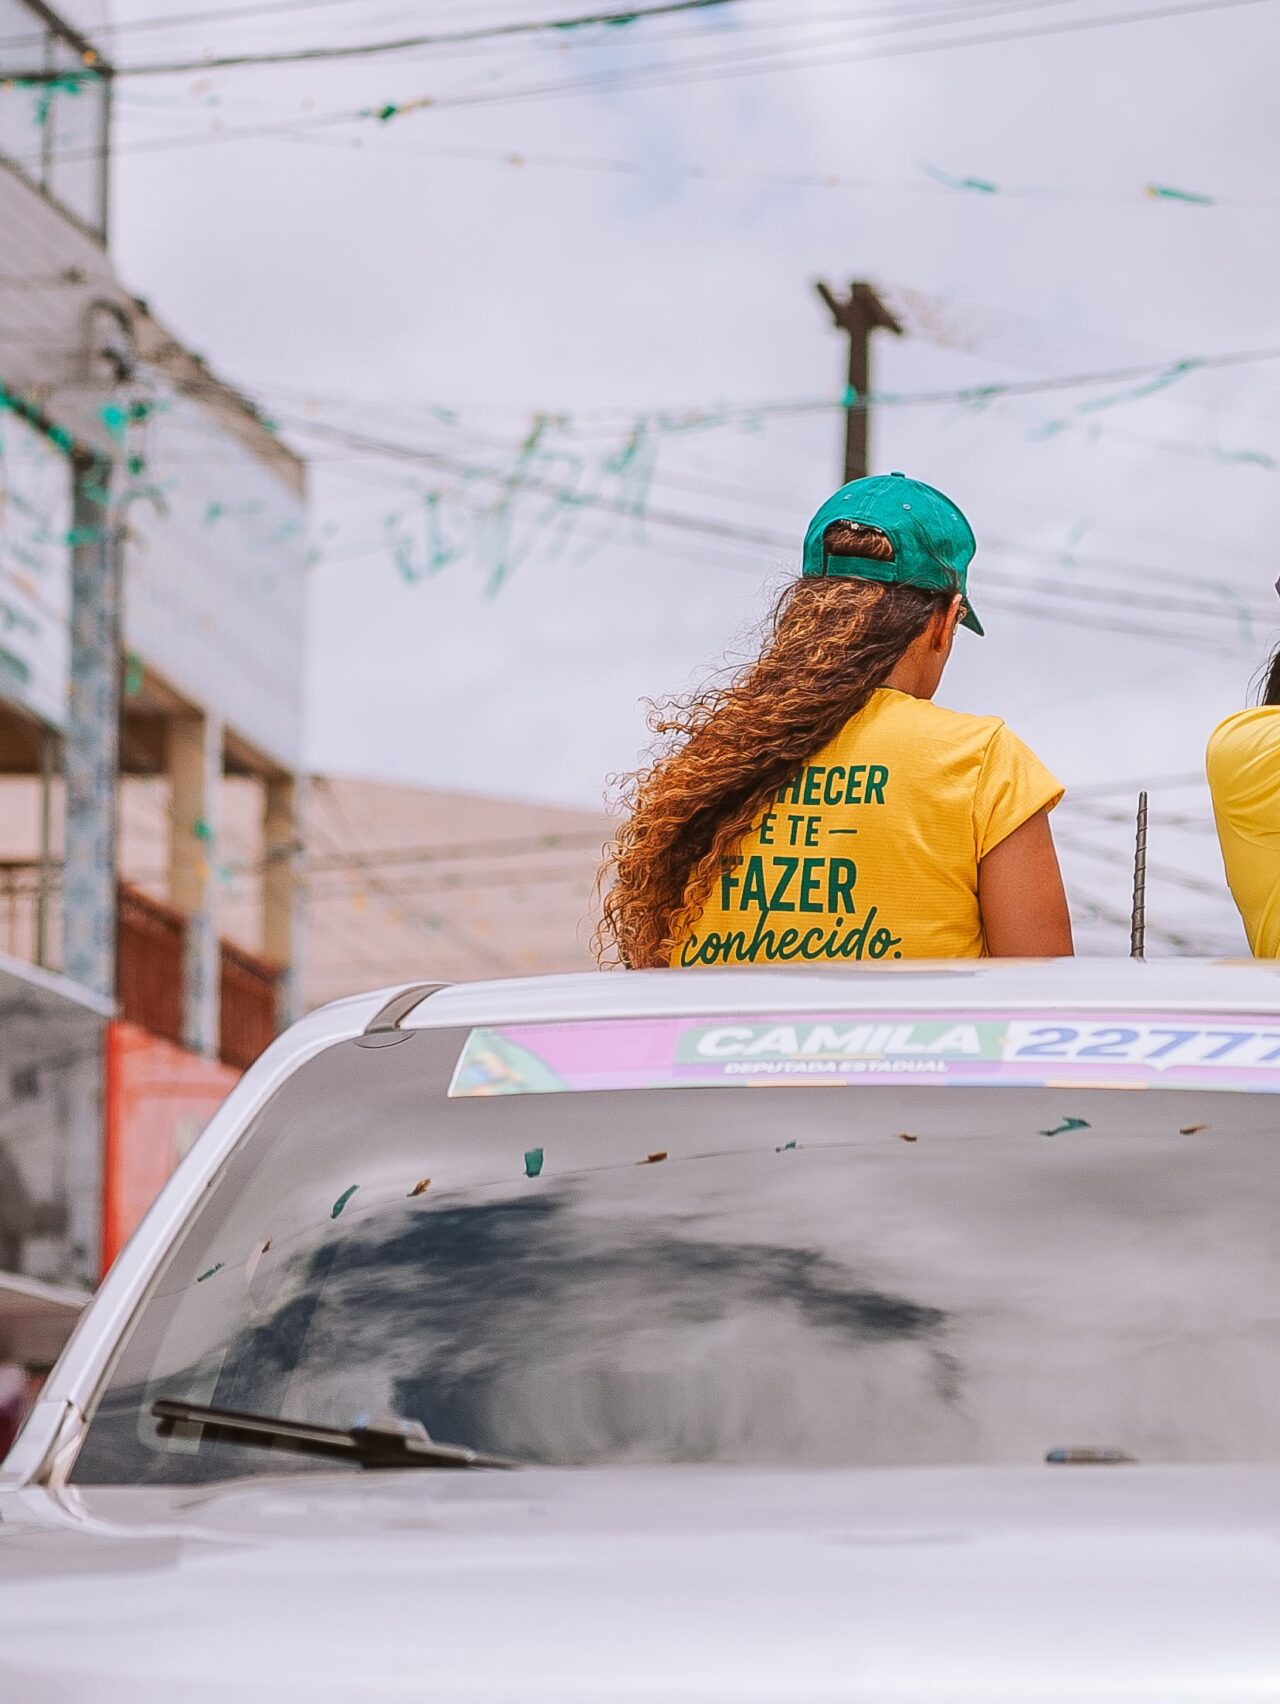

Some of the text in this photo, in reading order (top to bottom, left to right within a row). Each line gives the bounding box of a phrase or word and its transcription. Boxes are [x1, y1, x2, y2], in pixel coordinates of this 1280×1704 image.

[776, 765, 889, 806] HECER
[759, 813, 822, 847] E TE
[720, 855, 857, 914] FAZER
[680, 907, 902, 967] conhecido.
[696, 1023, 981, 1056] CAMILA
[724, 1059, 949, 1074] DEPUTADA ESTADUAL
